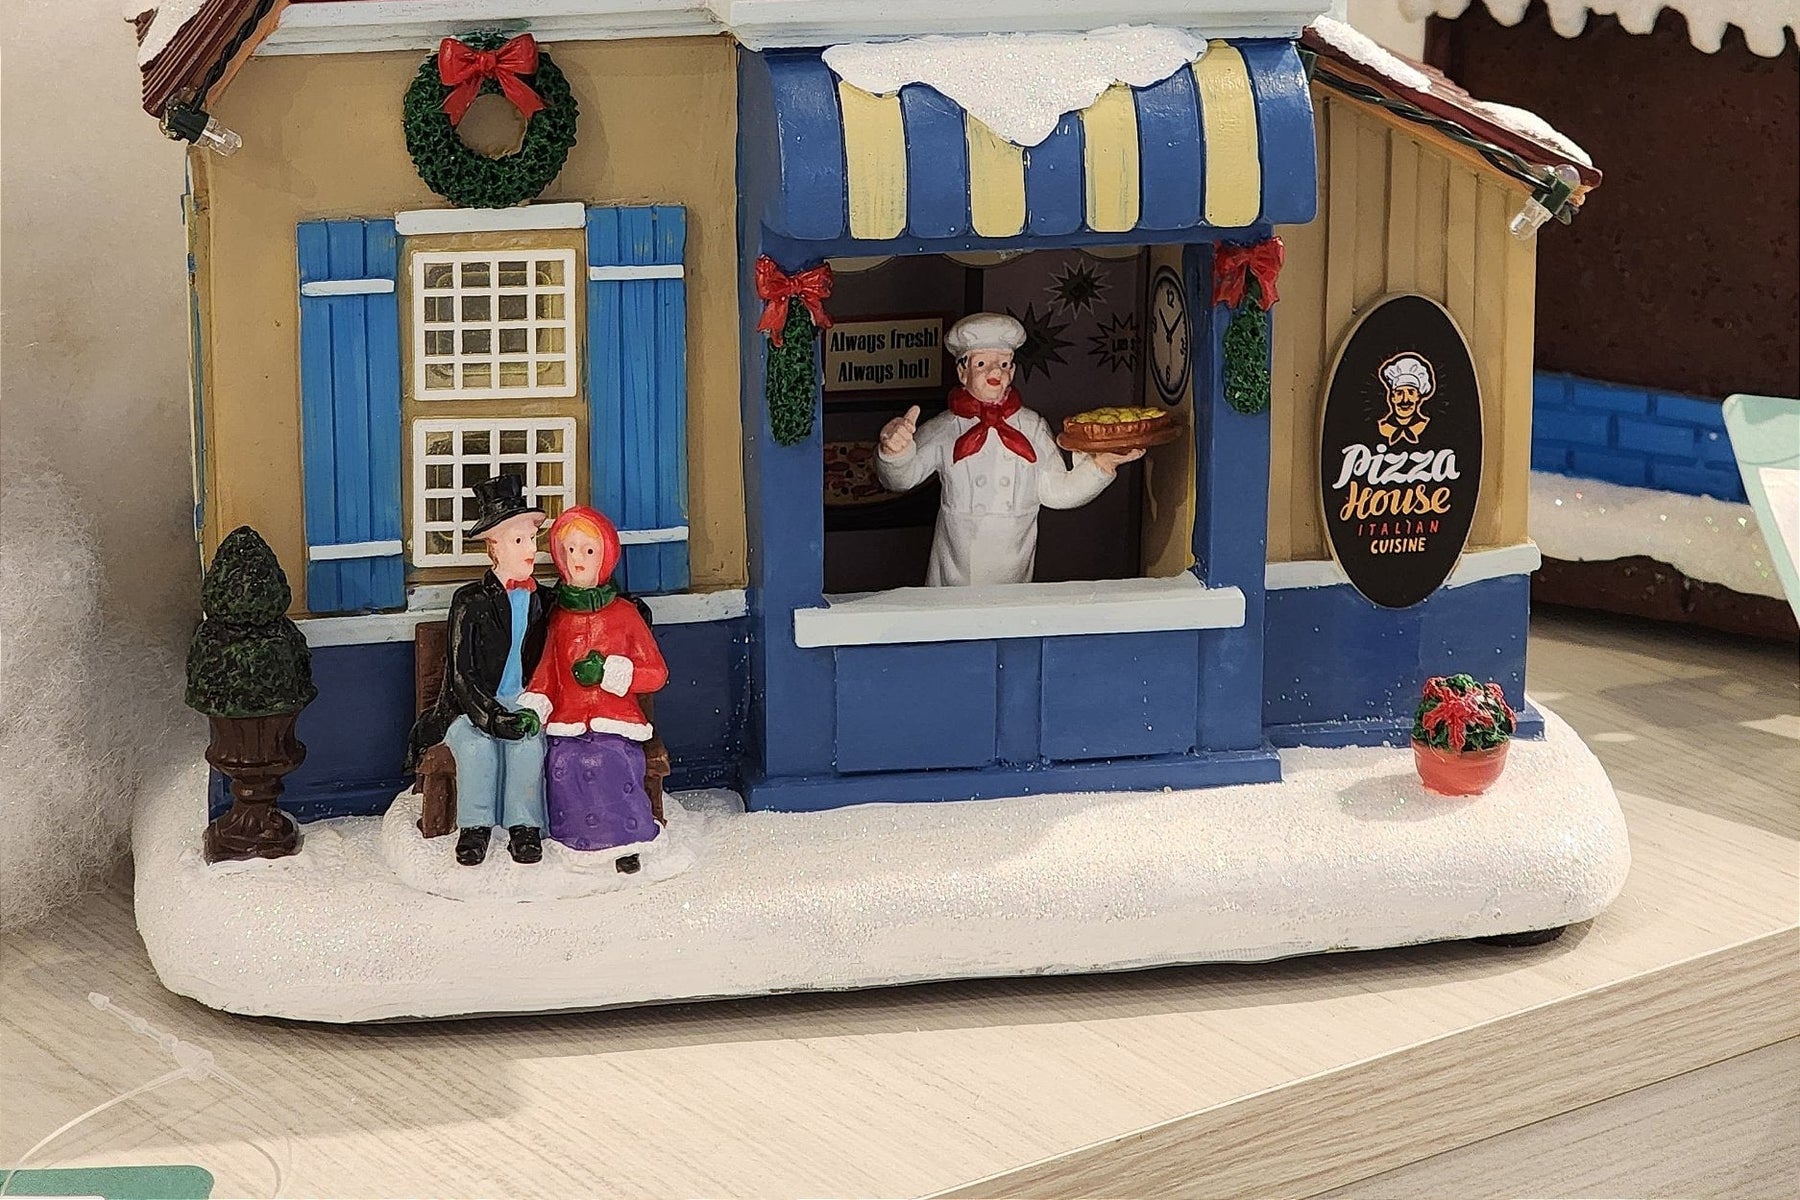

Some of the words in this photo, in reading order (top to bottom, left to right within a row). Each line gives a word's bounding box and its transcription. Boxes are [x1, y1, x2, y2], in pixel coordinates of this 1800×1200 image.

[830, 331, 886, 354] Always
[890, 326, 939, 349] fresh!
[838, 361, 893, 384] Always
[898, 358, 930, 380] hot!
[1332, 443, 1461, 490] Pizza
[1340, 481, 1451, 521] House
[1358, 519, 1440, 537] ITALIAN
[1370, 537, 1427, 554] CUISINE
